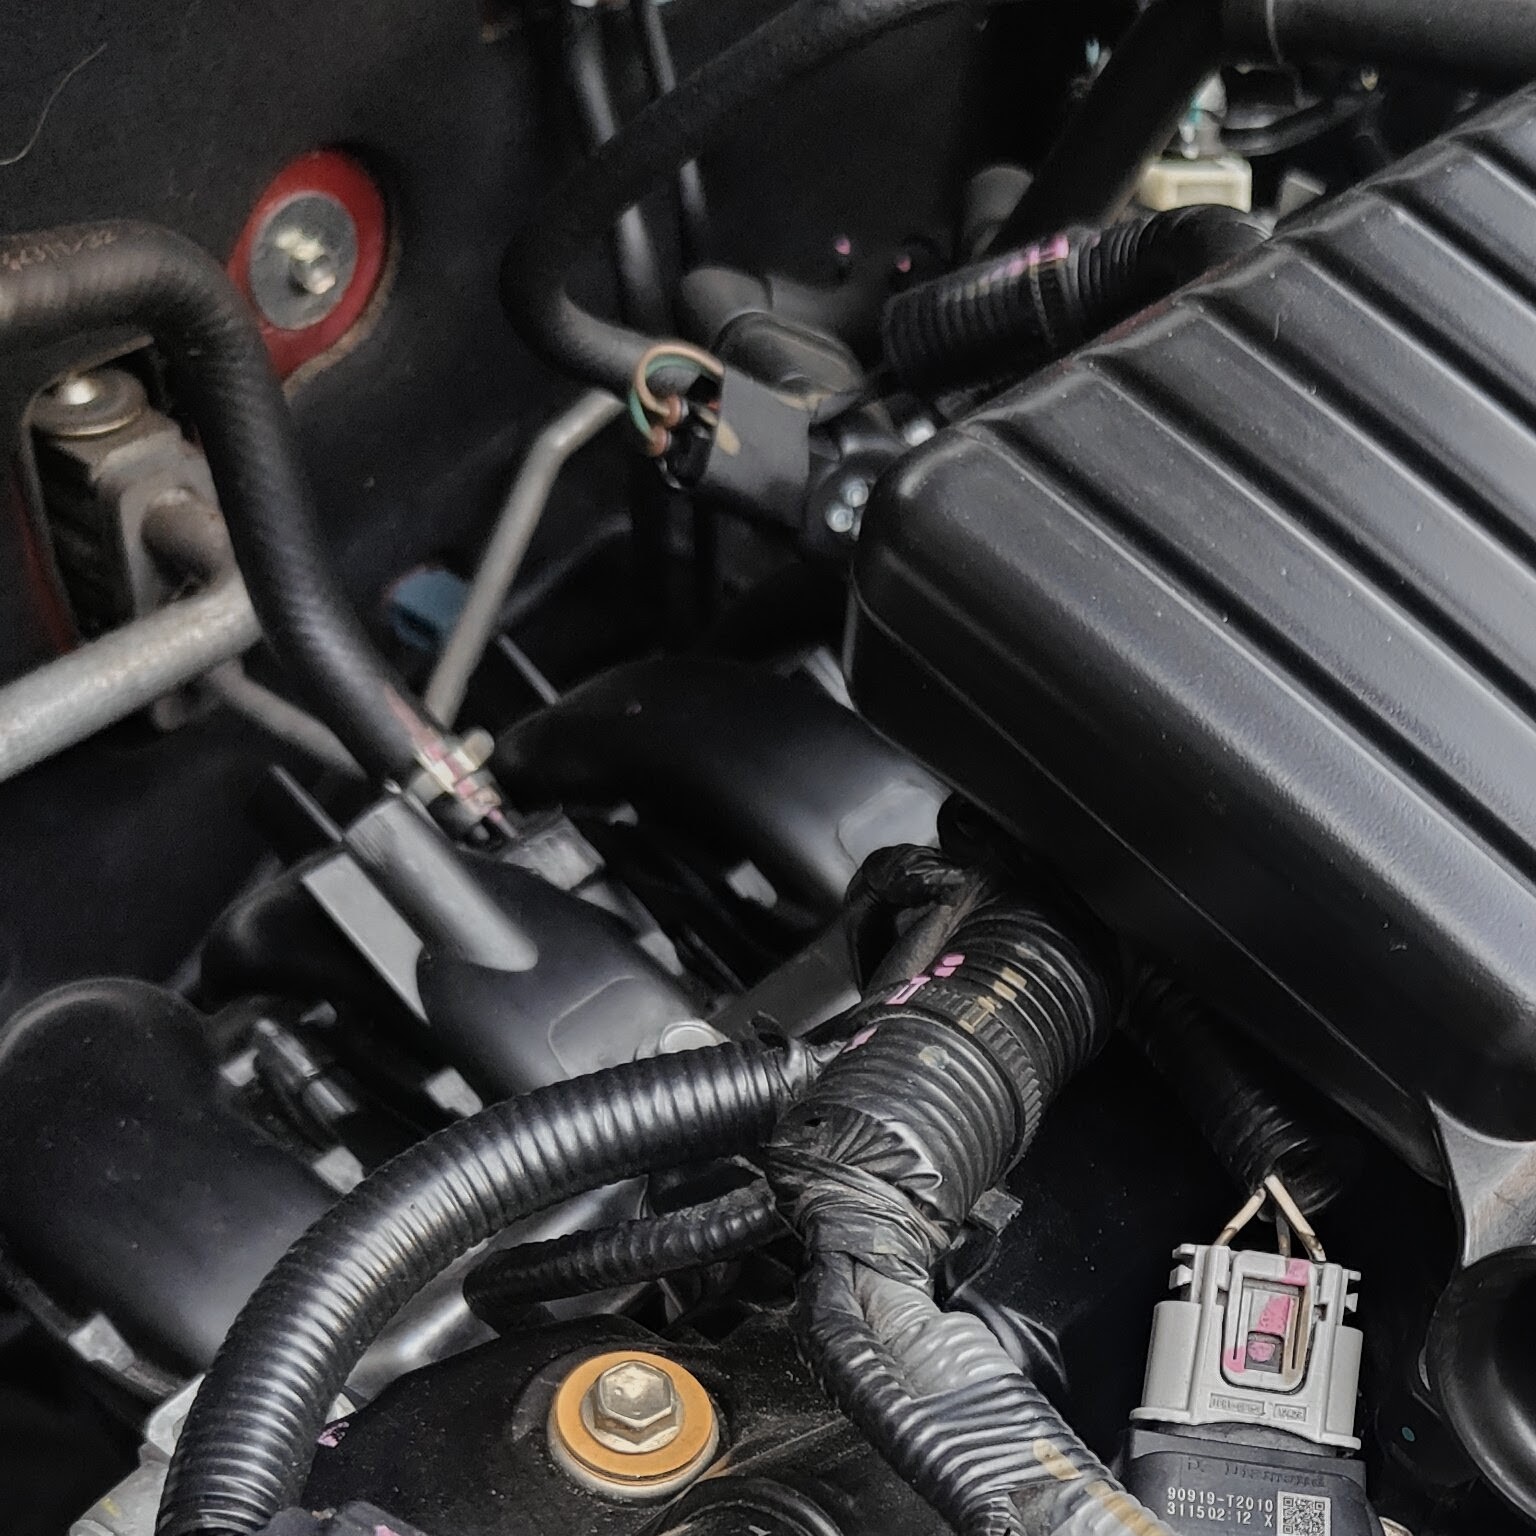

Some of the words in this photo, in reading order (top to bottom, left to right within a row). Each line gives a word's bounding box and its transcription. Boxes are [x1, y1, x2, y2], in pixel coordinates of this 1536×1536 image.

[1167, 1486, 1274, 1513] 90919-T2010
[1167, 1501, 1251, 1526] 311502:12
[1264, 1514, 1274, 1528] X
